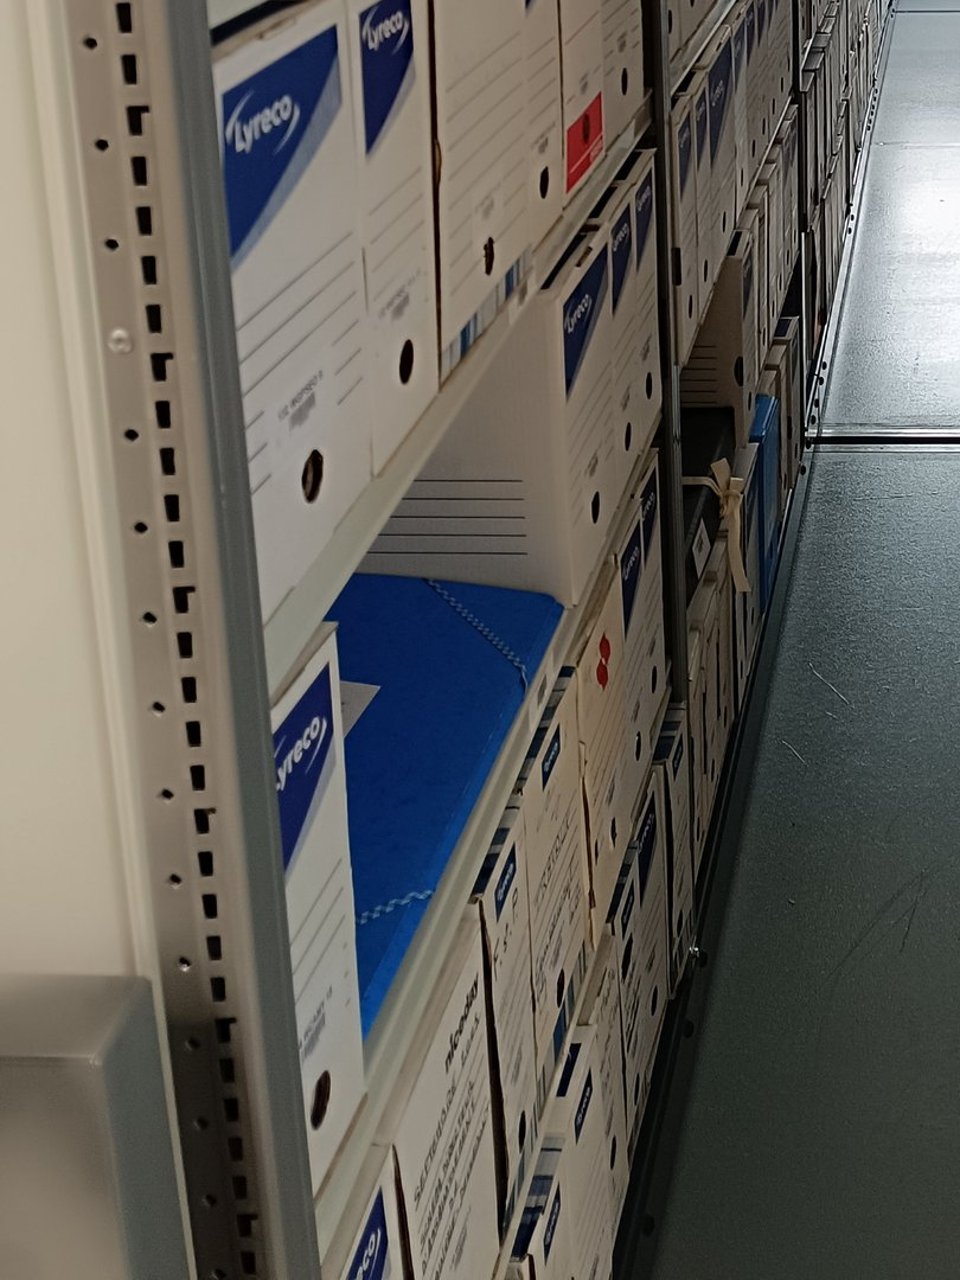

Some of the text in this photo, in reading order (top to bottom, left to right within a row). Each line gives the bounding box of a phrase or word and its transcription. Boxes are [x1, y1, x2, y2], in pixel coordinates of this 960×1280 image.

[367, 10, 405, 51] Lyreco
[234, 94, 293, 153] Lyreco
[275, 715, 320, 793] yreco
[445, 973, 478, 1072] niceday
